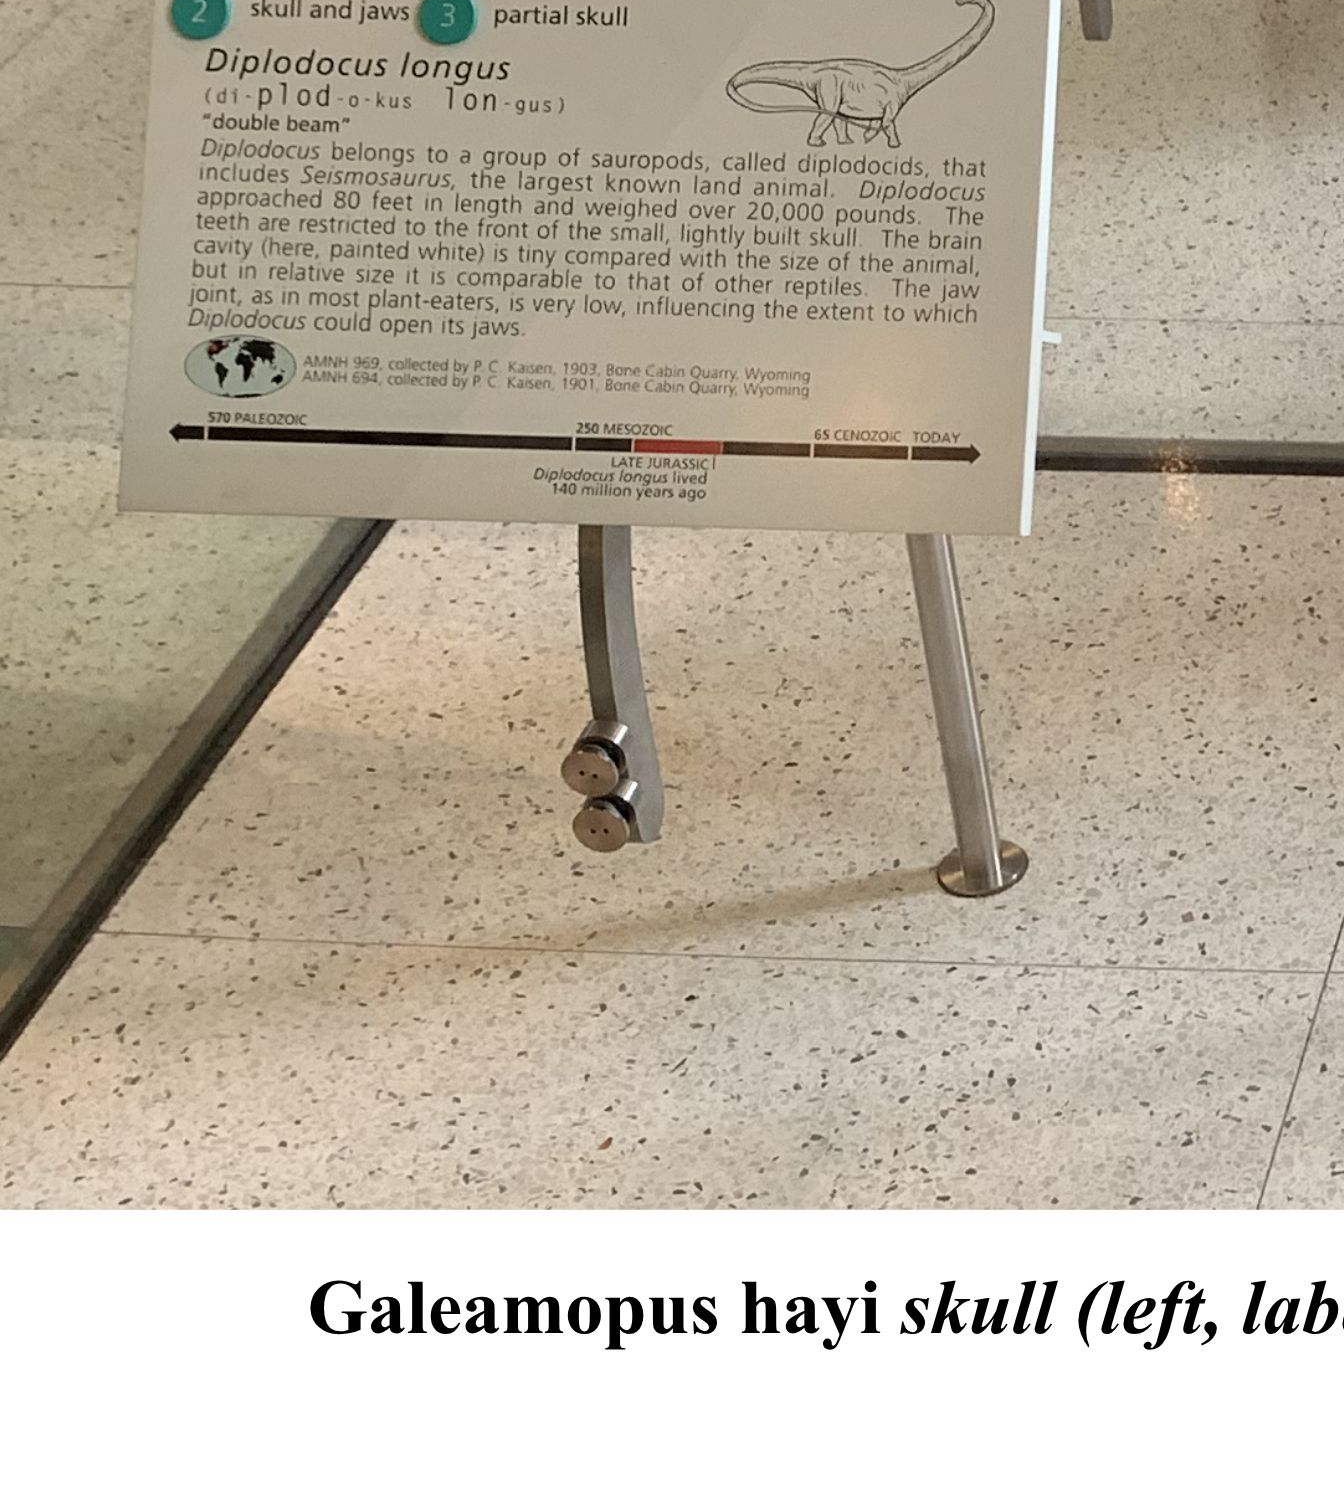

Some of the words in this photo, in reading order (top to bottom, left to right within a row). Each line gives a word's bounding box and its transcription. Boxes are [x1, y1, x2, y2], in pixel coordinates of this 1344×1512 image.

[309, 0, 353, 20] and
[359, 0, 410, 25] jaws
[439, 3, 456, 27] 3
[493, 4, 569, 29] partial
[576, 5, 628, 27] skull
[204, 47, 389, 86] Diplodocus
[400, 51, 511, 89] longus
[200, 137, 321, 167] Diplodocus
[331, 140, 415, 168] belongs
[427, 146, 449, 164] to
[459, 150, 472, 165] a
[481, 150, 547, 172] group
[557, 147, 581, 168] of
[591, 150, 710, 176] sauropods,
[722, 151, 786, 173] called
[797, 153, 930, 181] diplodocids,
[942, 156, 986, 178] that
[199, 160, 290, 184] includes
[299, 164, 456, 194] Seismosaurus,
[470, 166, 507, 190] the
[517, 168, 594, 198] largest
[605, 170, 681, 195] known
[693, 174, 742, 197] land
[753, 175, 835, 198] animal.
[858, 177, 986, 207] Diplodocus
[187, 304, 307, 332] Diplodocus
[313, 309, 372, 333] could
[379, 318, 433, 338] open
[441, 315, 465, 336] its
[471, 312, 525, 341] jaws.
[302, 354, 349, 369] AMNH
[387, 357, 450, 373] collected
[452, 358, 470, 377] by
[605, 363, 642, 378] Bone
[645, 363, 686, 379] Cabin
[743, 366, 811, 385] Wyoming
[207, 412, 232, 424] 570
[233, 412, 308, 426] PALEOZOIC
[575, 423, 600, 435] 250
[602, 423, 673, 437] MESOZOIC
[813, 429, 831, 441] 65
[833, 429, 902, 443] CENOZOIC
[912, 431, 961, 445] TODAY
[533, 465, 616, 487] Diplodocus
[618, 465, 669, 487] longus
[672, 467, 708, 486] lived
[610, 456, 643, 470] LATE
[646, 457, 709, 472] JURASSIC
[547, 479, 578, 496] 140
[580, 480, 632, 497] million
[635, 487, 675, 501] years
[677, 488, 707, 503] ago
